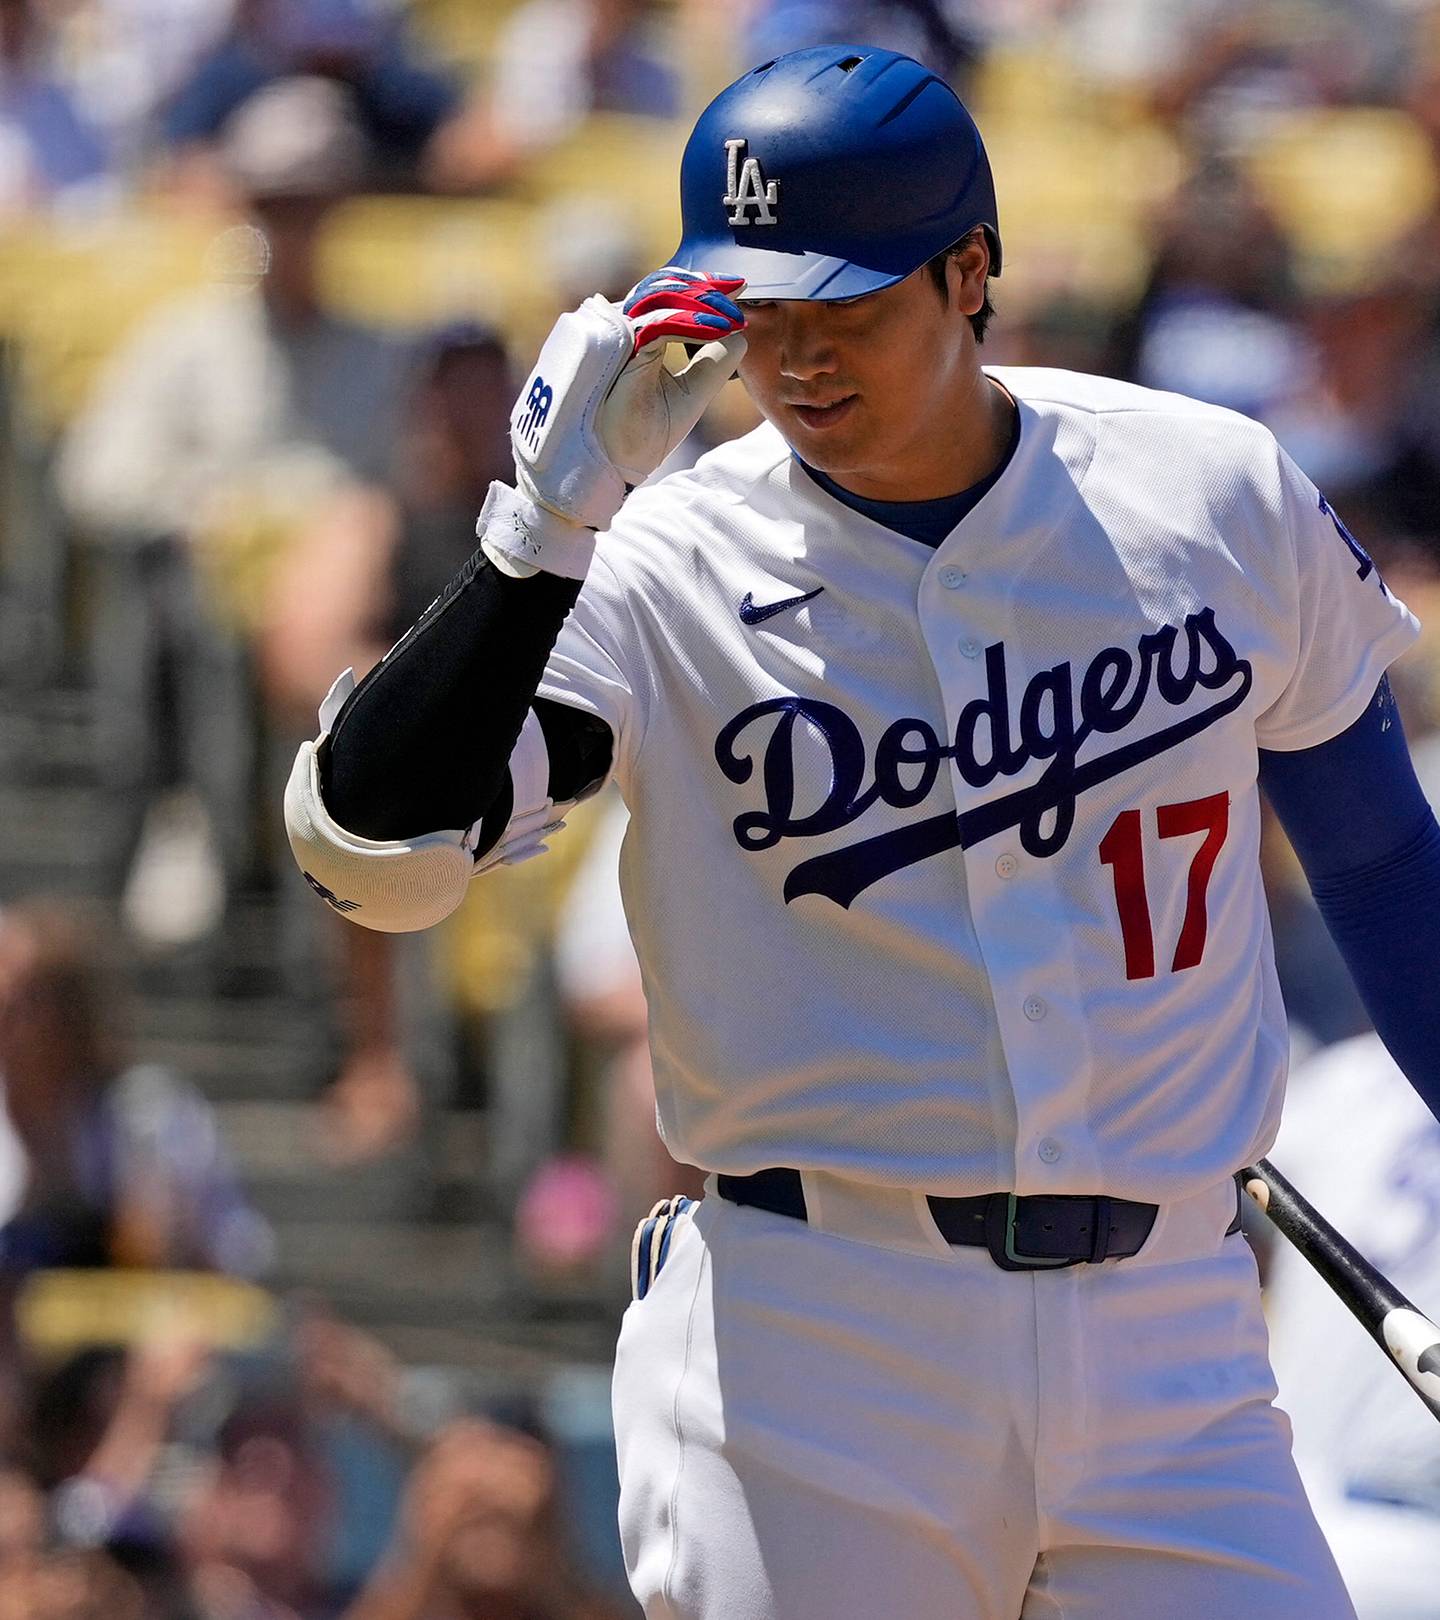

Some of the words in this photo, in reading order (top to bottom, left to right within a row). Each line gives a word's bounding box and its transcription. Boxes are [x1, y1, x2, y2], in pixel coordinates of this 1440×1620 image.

[723, 139, 778, 226] LA
[714, 606, 1253, 858] Dodgers
[1098, 790, 1230, 980] 17
